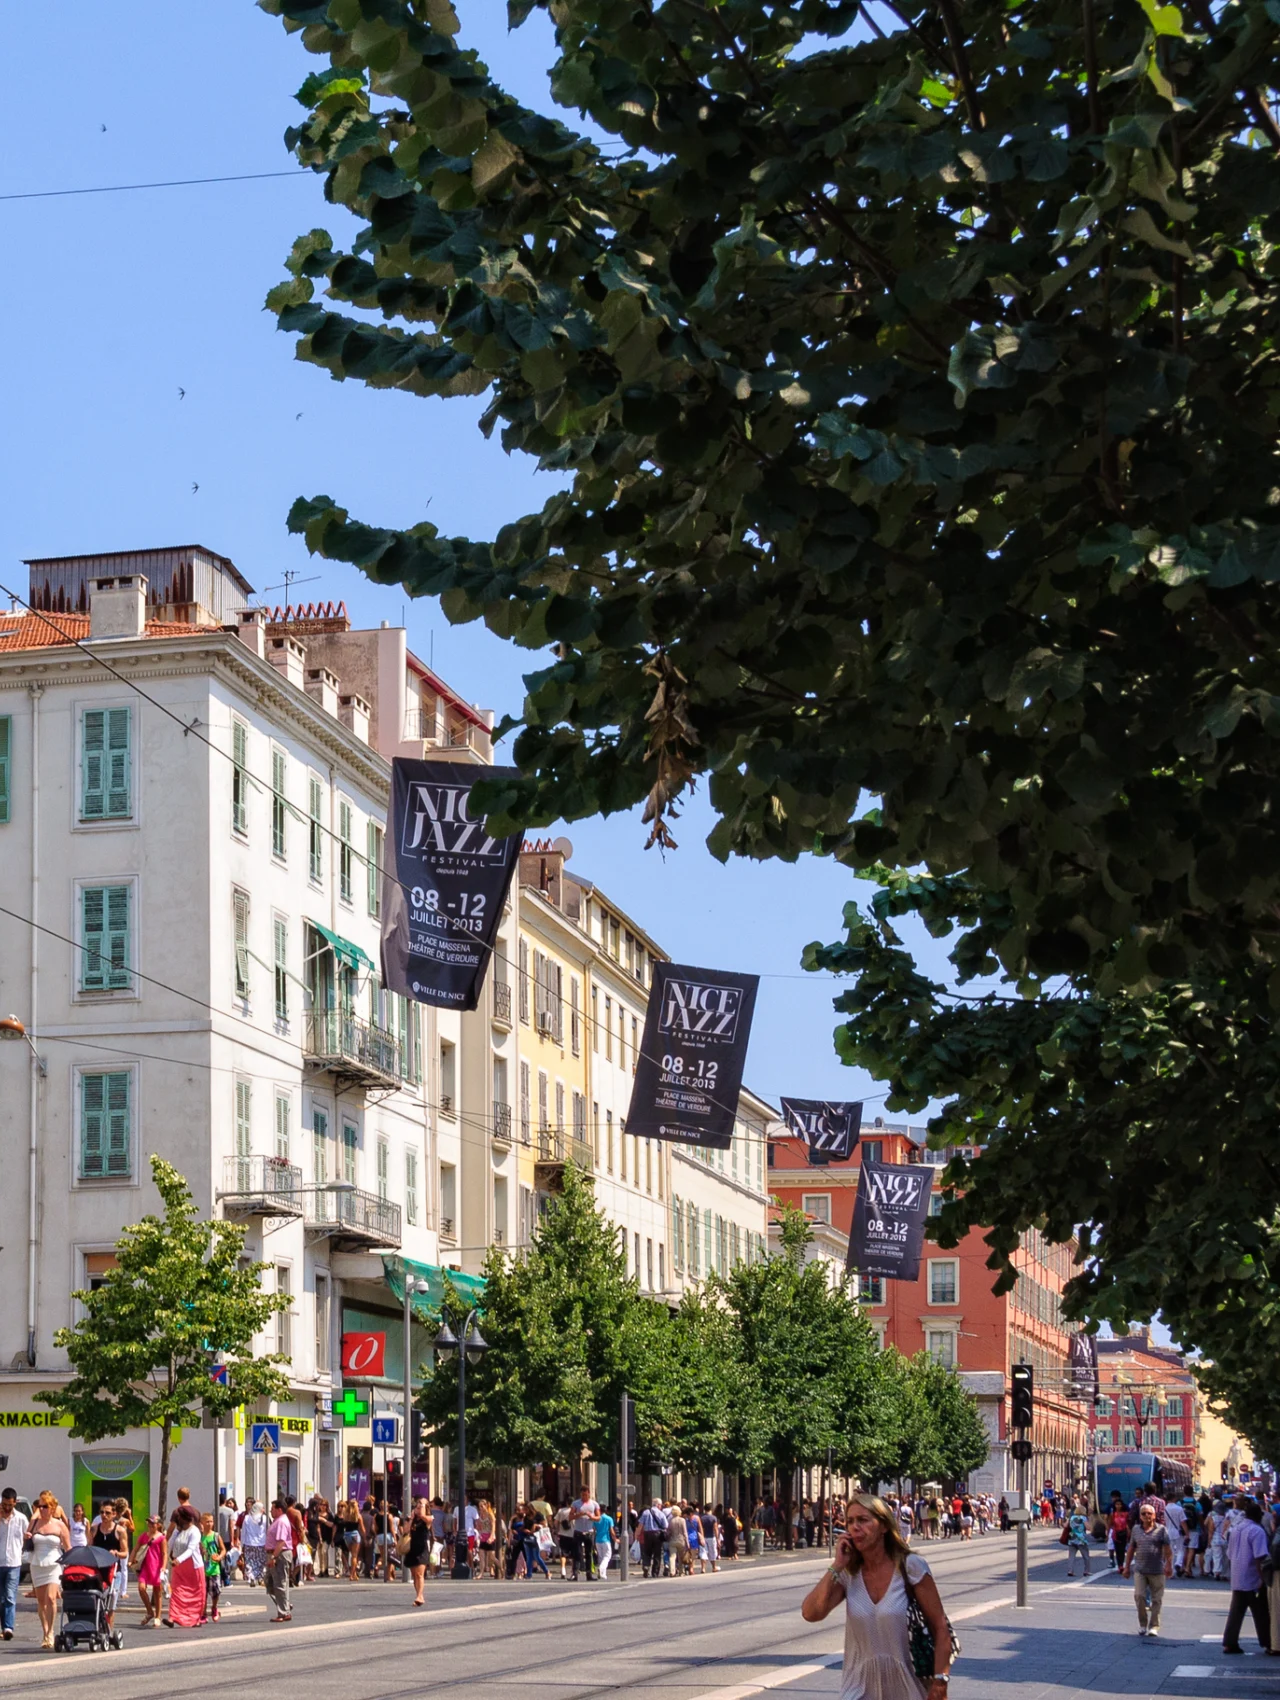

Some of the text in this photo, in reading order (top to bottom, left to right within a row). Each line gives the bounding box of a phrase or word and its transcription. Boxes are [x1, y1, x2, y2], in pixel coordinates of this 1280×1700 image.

[416, 786, 488, 824] NIC
[405, 812, 502, 856] JAZZ
[422, 855, 485, 867] FESTIVAL
[411, 886, 439, 911] 08
[410, 909, 483, 932] JUILLET 2013
[417, 934, 471, 952] PLACE MASSENA
[436, 951, 445, 960] DE
[446, 953, 480, 964] VERDURE
[420, 985, 465, 1001] VILLE DE NICE
[670, 982, 739, 1016] NICE
[661, 1000, 734, 1036] JAZZ
[673, 1032, 718, 1044] FESTIVAL
[661, 1054, 684, 1074] 08
[659, 1073, 715, 1089] JUILLET 2013
[663, 1091, 680, 1100] PLACE
[686, 1102, 711, 1112] VERDURE
[873, 1173, 921, 1193] NICE
[869, 1185, 920, 1207] JAZZ
[868, 1219, 884, 1232] 08
[889, 1234, 907, 1242] 2013
